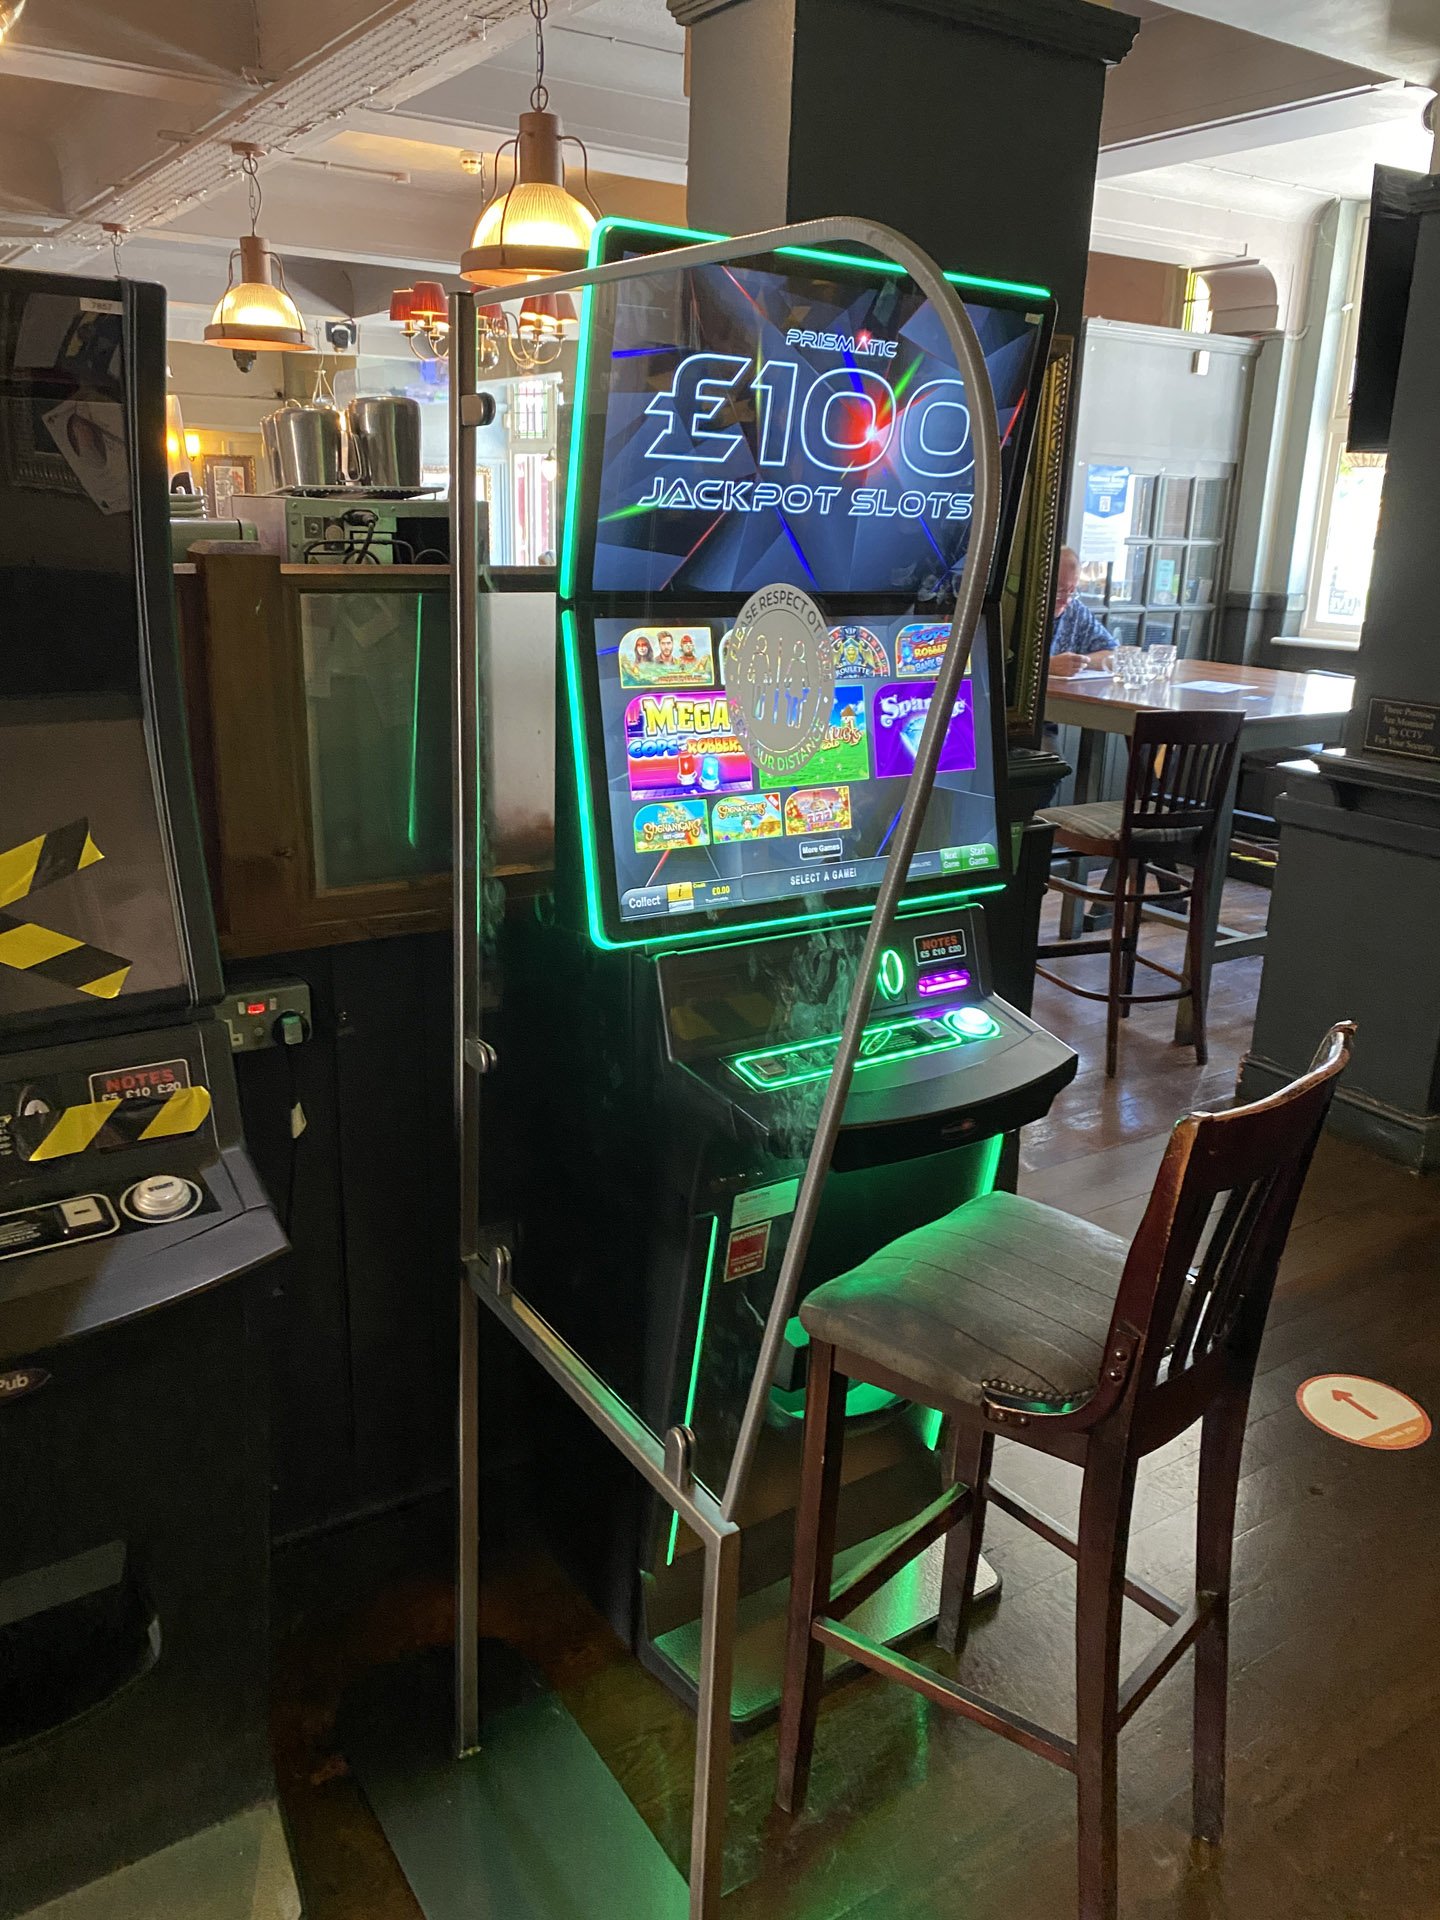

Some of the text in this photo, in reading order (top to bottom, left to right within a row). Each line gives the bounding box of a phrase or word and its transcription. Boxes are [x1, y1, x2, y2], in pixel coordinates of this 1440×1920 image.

[786, 328, 898, 358] PRISMATIC
[644, 353, 977, 478] £100
[637, 476, 974, 520] JACKPOT SLOTS
[759, 590, 808, 614] RESPECT
[914, 643, 948, 658] ROBBER
[642, 696, 731, 737] MEGA
[879, 694, 966, 728] Spare
[1400, 728, 1424, 739] CCTV
[628, 735, 744, 758] COPS ROBBER
[643, 818, 702, 842] SHENANIGANS
[802, 843, 840, 855] More Games
[969, 847, 986, 856] Start
[968, 857, 989, 866] Game
[790, 867, 857, 885] SELECT A GAME!
[712, 885, 731, 896] £0.00
[629, 895, 661, 909] Collect
[921, 935, 958, 950] NOTES
[920, 950, 930, 958] £5
[932, 948, 946, 957] £10
[105, 1068, 175, 1092] NOTES
[125, 1087, 151, 1099] £10
[157, 1081, 181, 1094] £20
